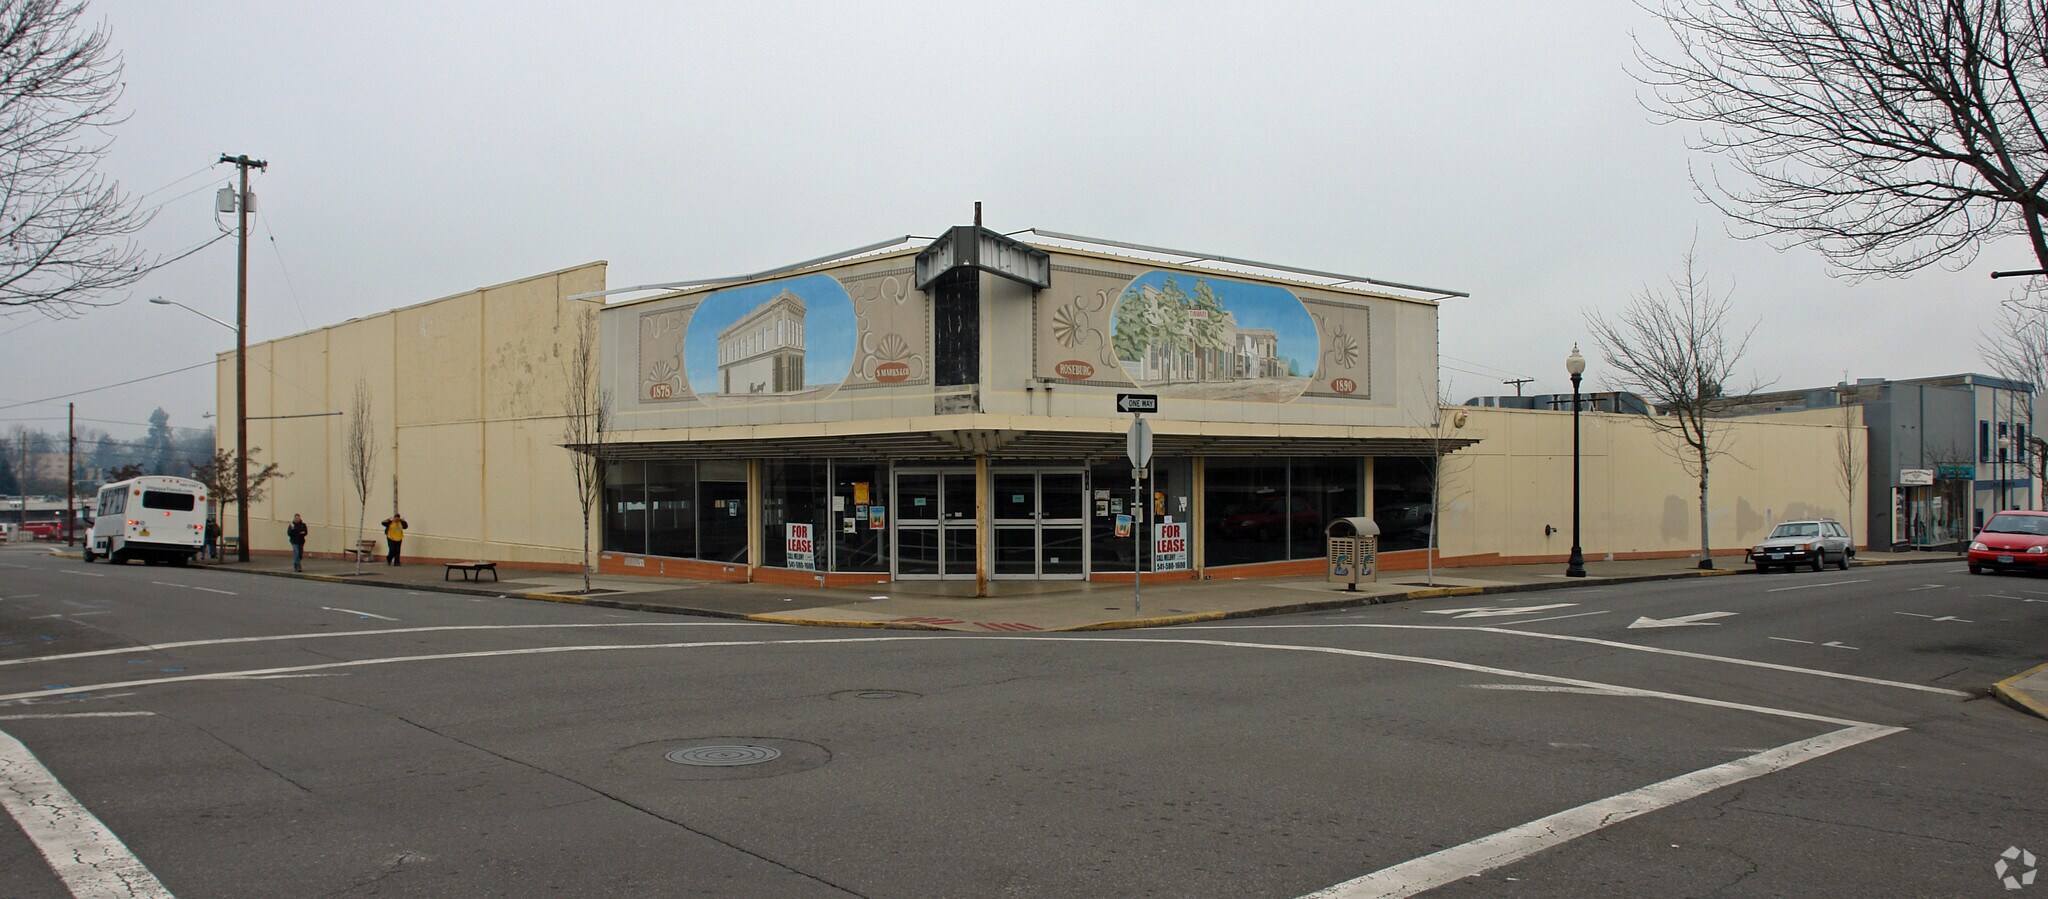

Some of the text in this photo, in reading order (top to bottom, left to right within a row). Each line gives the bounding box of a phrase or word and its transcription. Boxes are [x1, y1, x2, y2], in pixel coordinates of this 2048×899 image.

[1059, 363, 1092, 376] ROSEBURG
[653, 384, 671, 398] 1878
[1336, 380, 1353, 392] 1890
[1129, 399, 1154, 408] ONE WAY
[791, 525, 808, 539] FOR
[1161, 525, 1180, 539] FOR
[787, 539, 812, 553] LEASE
[1157, 539, 1185, 553] LEASE
